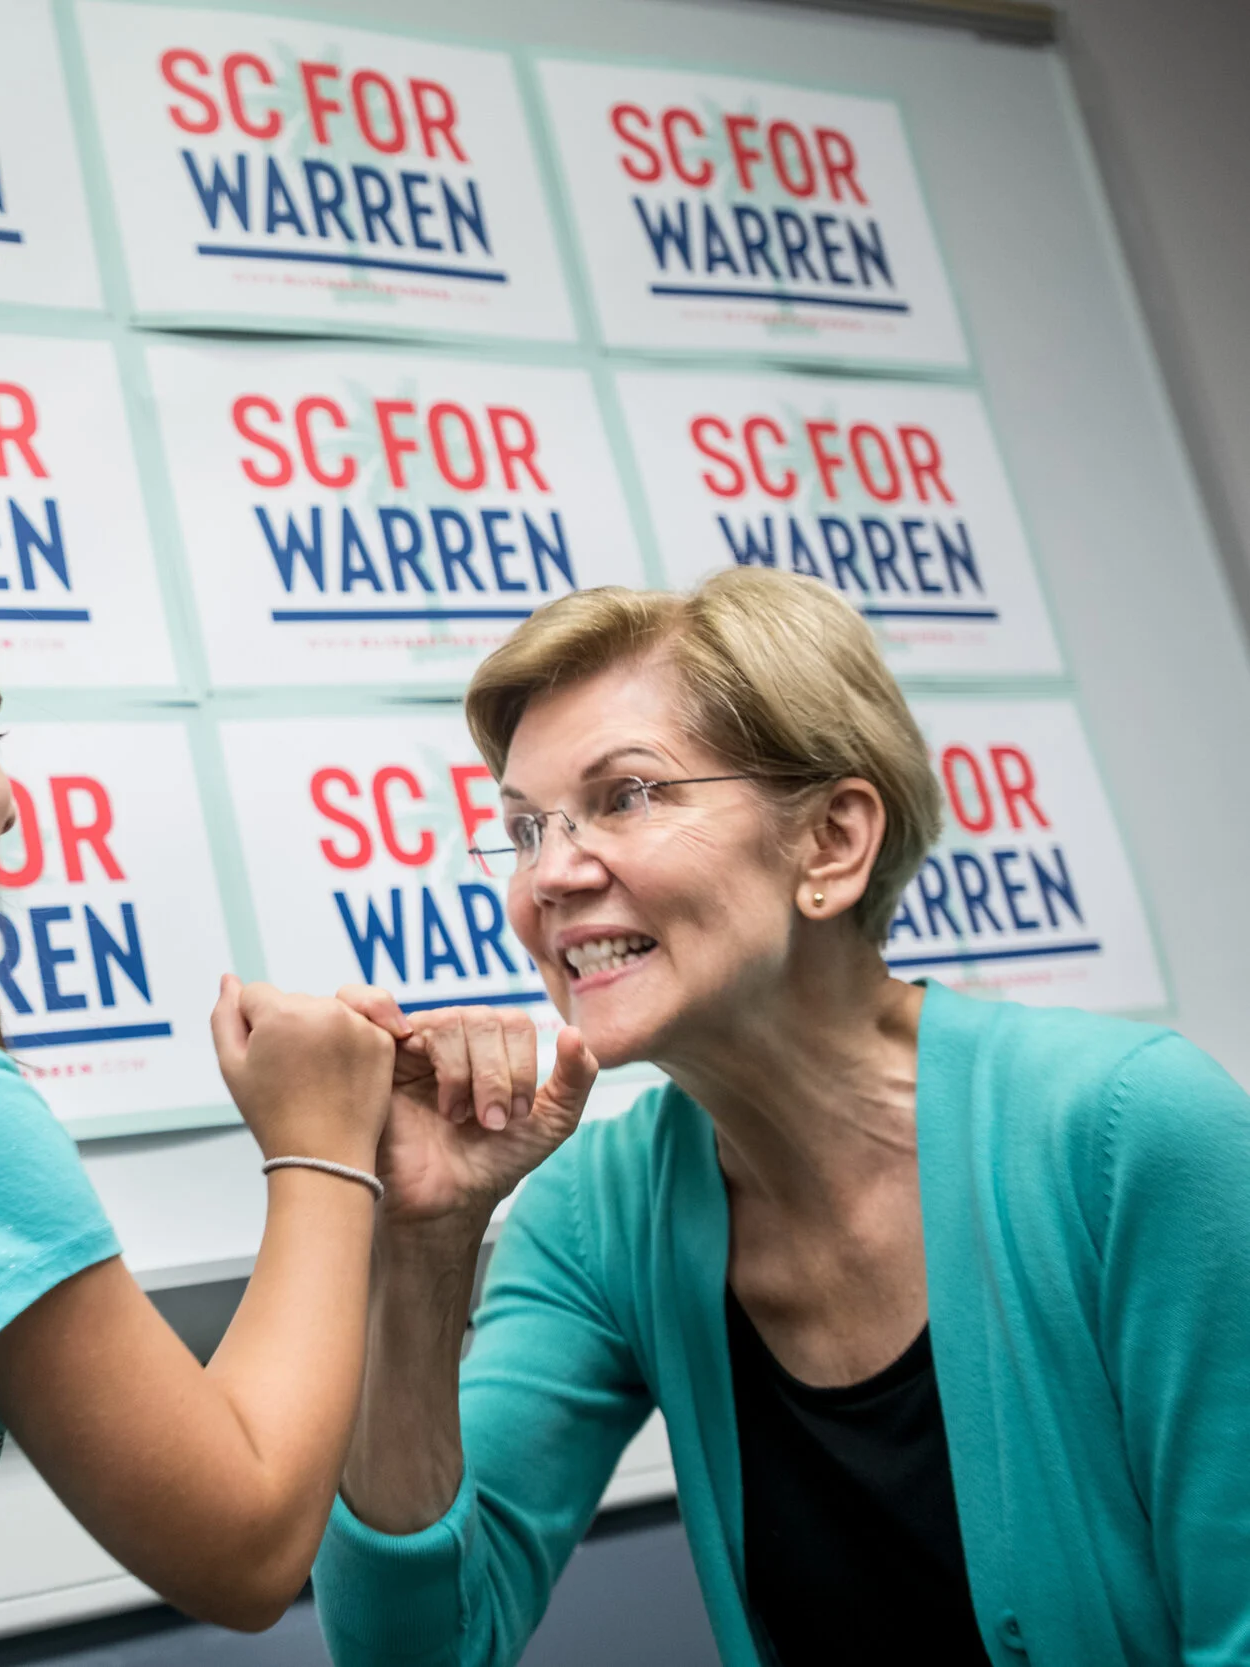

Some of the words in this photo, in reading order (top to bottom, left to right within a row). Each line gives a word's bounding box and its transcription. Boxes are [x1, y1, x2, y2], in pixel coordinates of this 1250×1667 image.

[159, 48, 283, 140] SC
[300, 61, 468, 163] FOR
[609, 103, 716, 188] SC
[725, 115, 869, 205] FOR
[181, 150, 494, 256] WARREN
[633, 197, 896, 289] WARREN
[231, 394, 358, 489] SC
[374, 399, 550, 493] FOR
[689, 415, 798, 500] SC
[805, 420, 954, 504] FOR
[255, 506, 578, 591] WARREN
[717, 512, 986, 593] WARREN
[309, 765, 436, 871] SC
[940, 744, 1052, 835] OR
[333, 882, 537, 985] WAR
